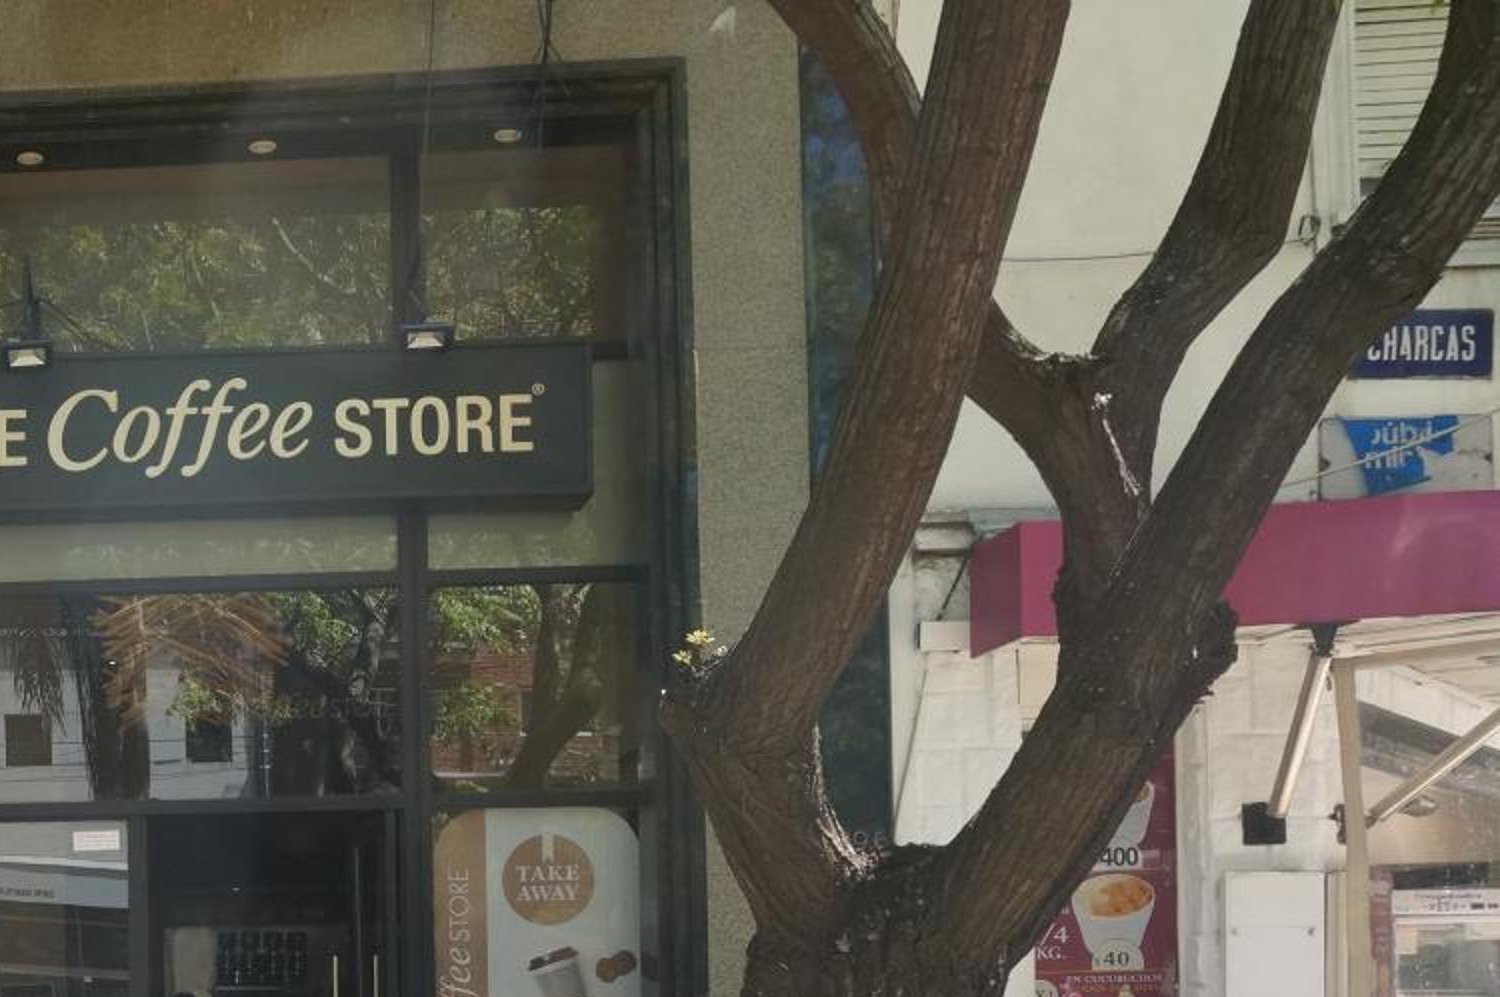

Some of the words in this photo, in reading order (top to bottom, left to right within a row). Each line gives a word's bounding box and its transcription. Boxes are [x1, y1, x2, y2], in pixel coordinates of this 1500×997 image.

[47, 377, 313, 479] Coffee
[334, 394, 535, 458] STORE
[515, 864, 580, 882] TAKE
[448, 868, 470, 943] STORE
[516, 883, 580, 903] AWAY
[1039, 922, 1070, 948] /4
